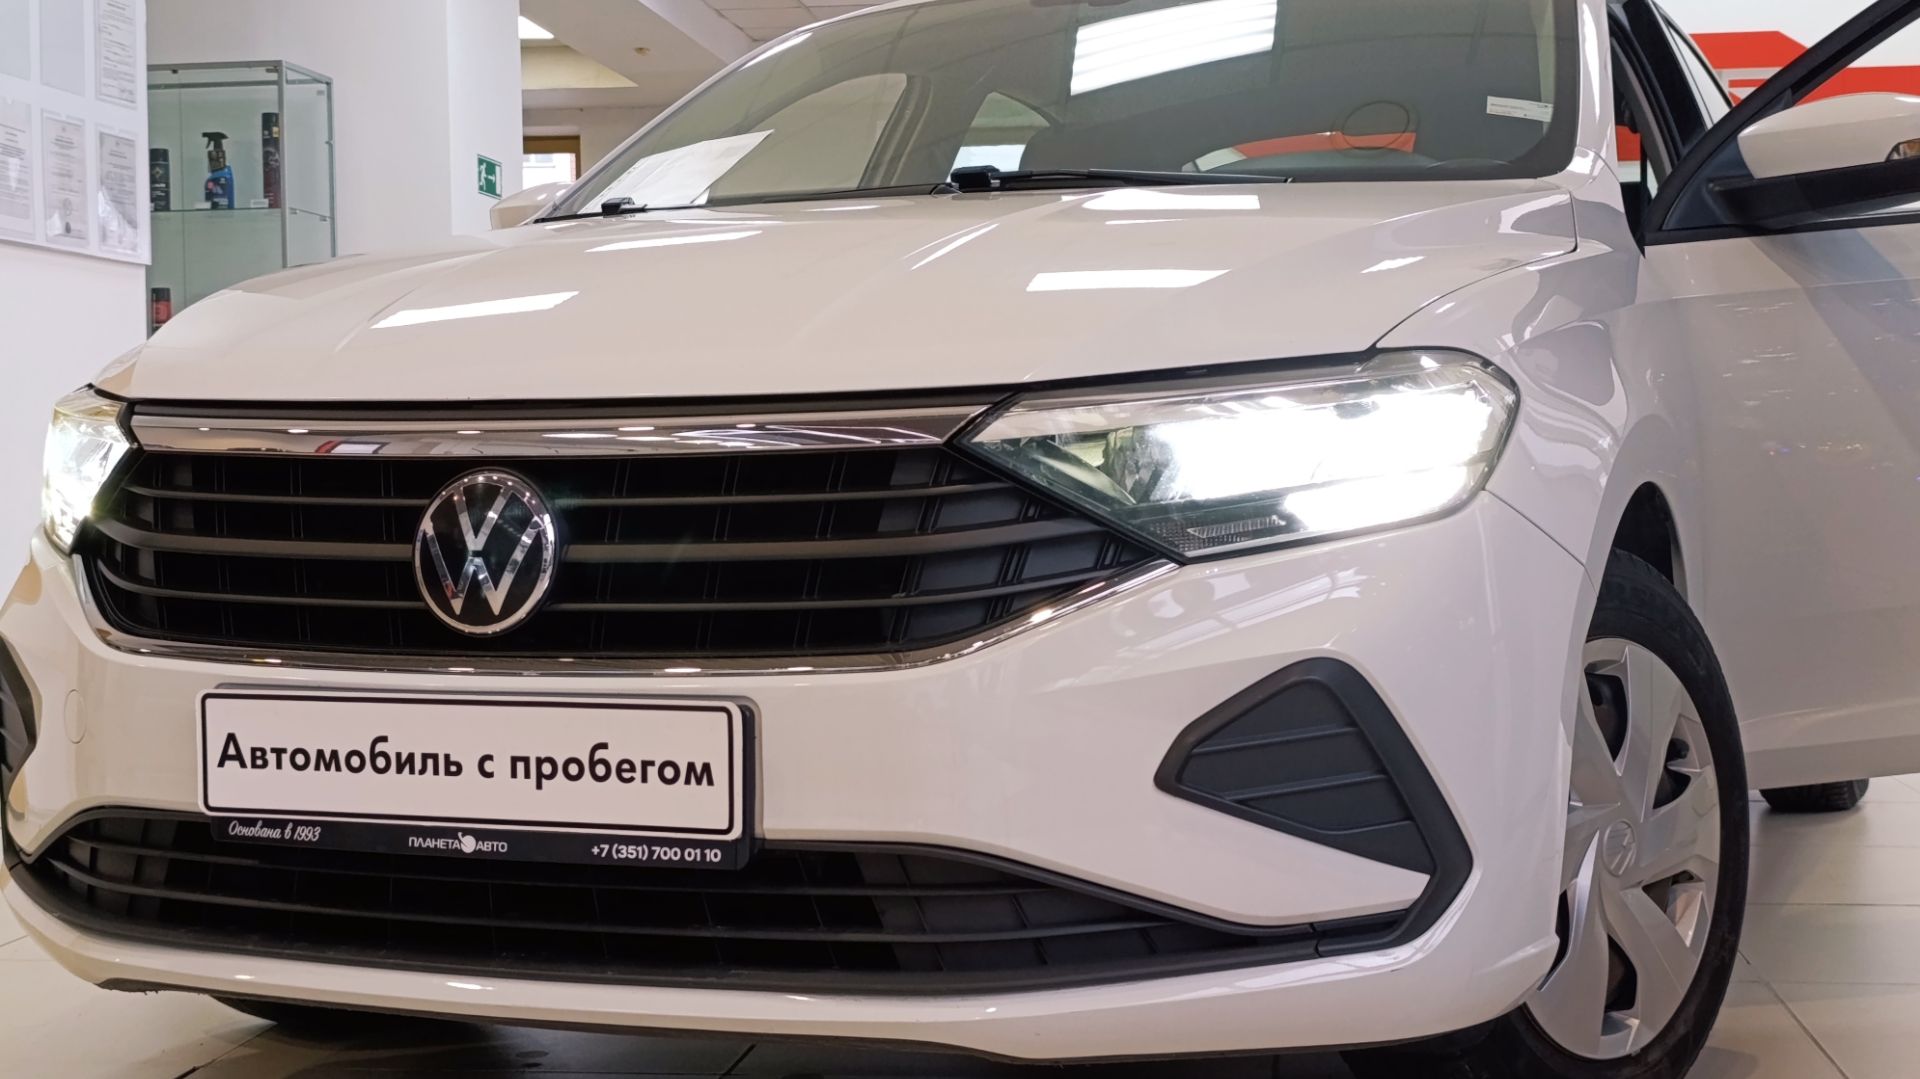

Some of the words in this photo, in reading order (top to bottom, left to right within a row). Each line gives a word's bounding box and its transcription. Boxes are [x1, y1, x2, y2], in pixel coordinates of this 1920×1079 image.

[217, 732, 463, 777] Автомобиль
[477, 753, 495, 778] с
[510, 741, 715, 791] пробегом
[228, 819, 281, 839] Основана
[283, 822, 294, 840] в
[294, 825, 322, 842] 1993
[591, 843, 610, 859] +7
[611, 843, 649, 861] (351)
[651, 846, 681, 861] 700
[683, 848, 701, 862] 01
[704, 848, 722, 863] 10
